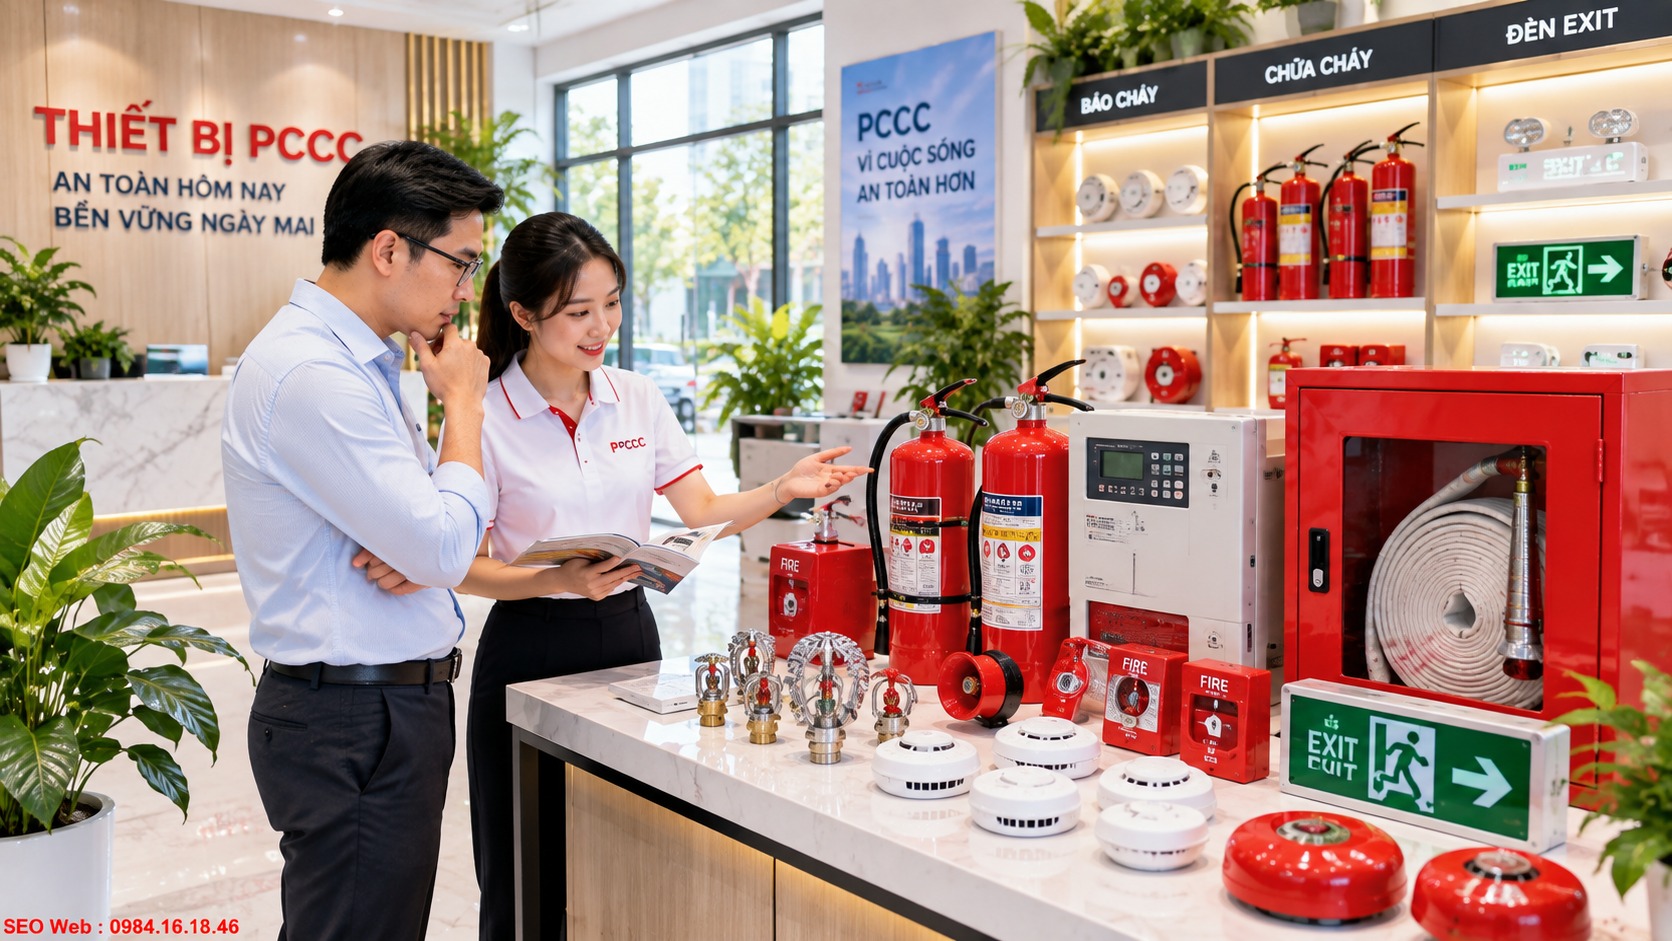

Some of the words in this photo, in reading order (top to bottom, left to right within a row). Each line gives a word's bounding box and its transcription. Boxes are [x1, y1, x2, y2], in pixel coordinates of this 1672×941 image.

[1506, 17, 1556, 45] ĐÈN
[1564, 7, 1619, 36] EXIT
[1265, 57, 1317, 84] CHỮA
[1320, 46, 1374, 76] CHÁY
[34, 100, 177, 152] THIẾT
[192, 120, 232, 166] BỊ
[250, 124, 363, 164] PCCC
[857, 102, 931, 142] PCCC
[876, 144, 922, 172] CUỘC
[927, 137, 976, 164] SỐNG
[53, 171, 91, 192] AN
[100, 170, 169, 197] TOÀN
[178, 174, 233, 198] HÔM
[241, 182, 286, 201] NAY
[857, 183, 880, 203] AN
[885, 174, 931, 200] TOÀN
[935, 170, 976, 194] HƠN
[118, 205, 193, 232] VỮNG
[201, 210, 267, 234] NGÀY
[274, 217, 315, 236] MAI
[1507, 261, 1540, 278] EXIT
[781, 557, 800, 572] FIRE
[1122, 657, 1148, 675] FIRE
[1200, 674, 1229, 693] FIRE
[1308, 729, 1359, 762] EXIT
